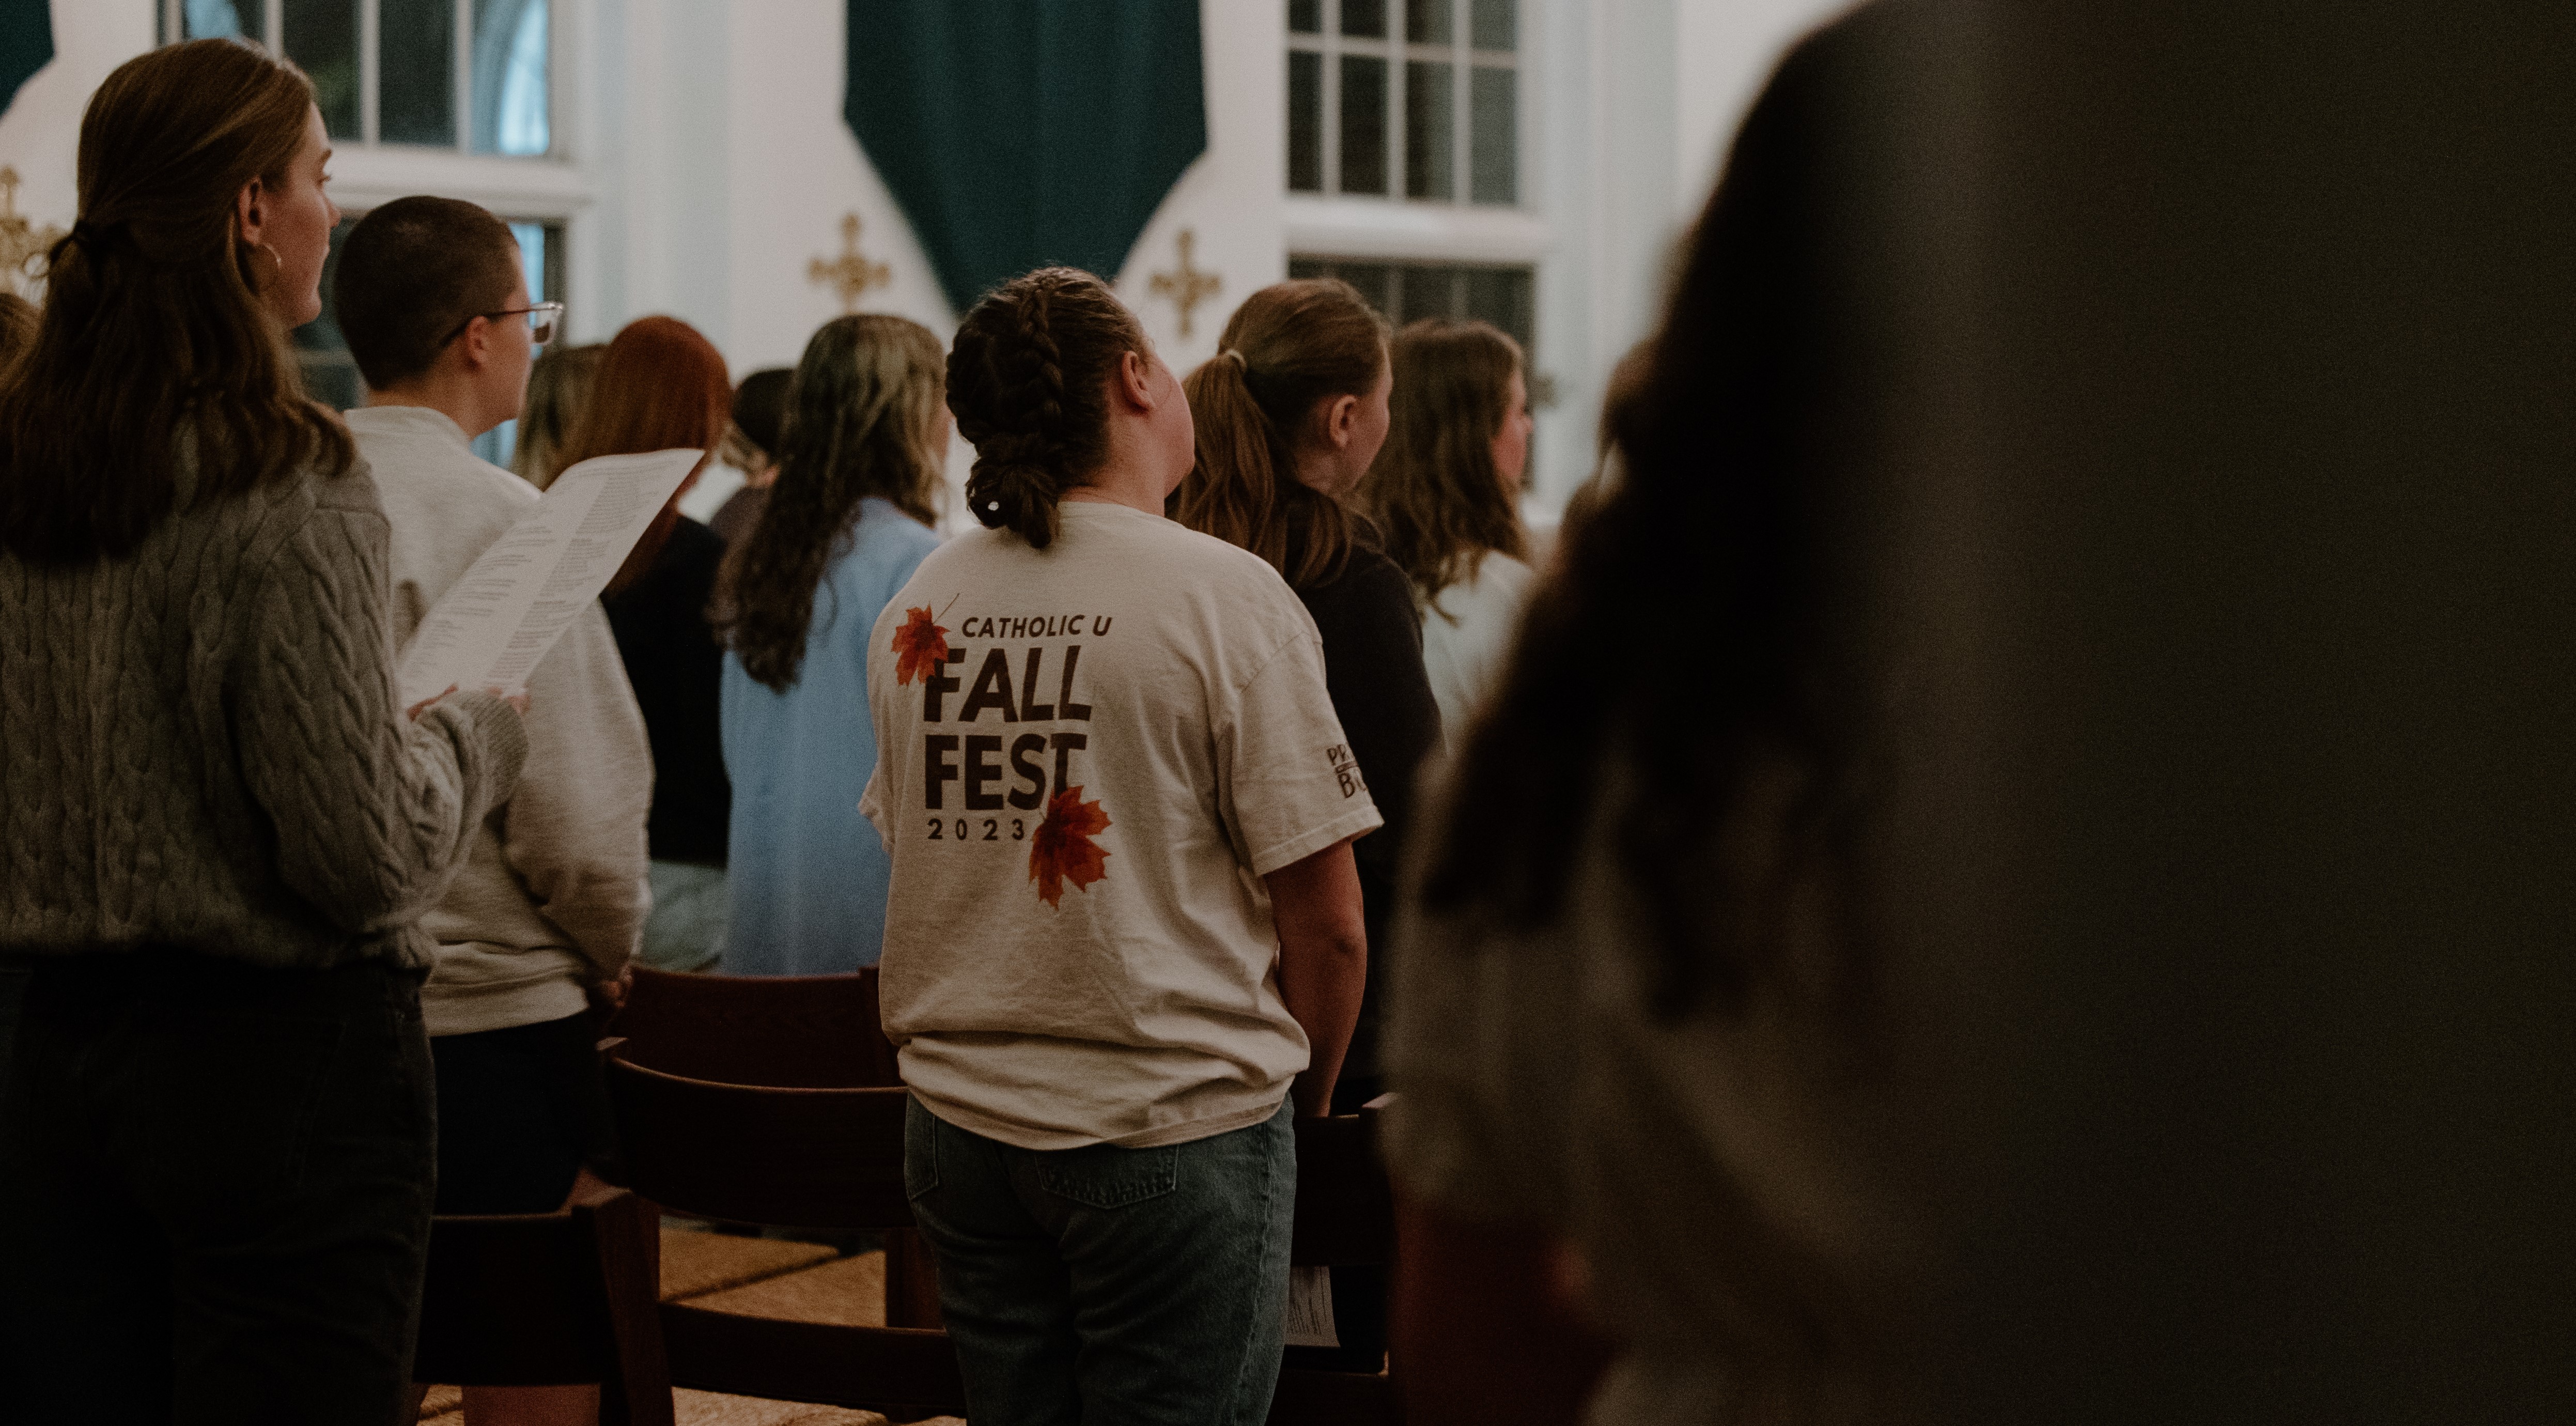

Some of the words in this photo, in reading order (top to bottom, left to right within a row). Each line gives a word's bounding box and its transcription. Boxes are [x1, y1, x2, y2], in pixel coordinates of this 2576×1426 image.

[961, 615, 1085, 638] CATHOLIC
[1093, 616, 1112, 636] U
[924, 645, 1092, 722] FALL
[925, 733, 1087, 810] FEST
[927, 819, 1025, 841] 2023
